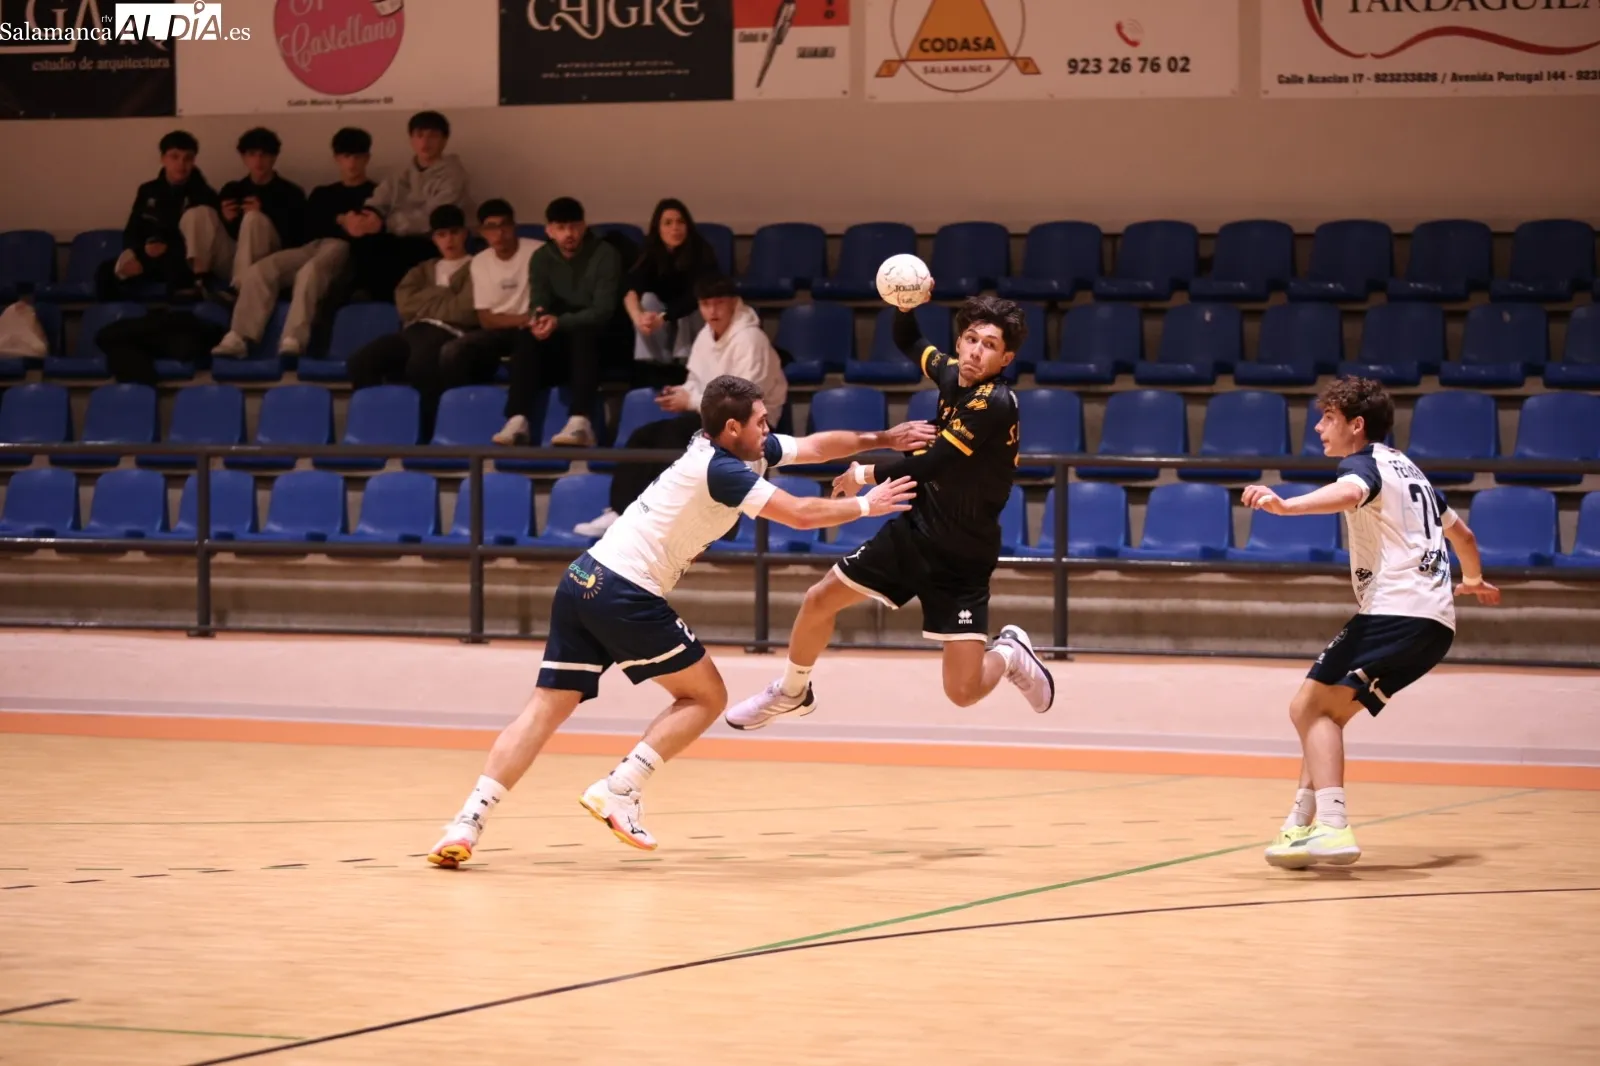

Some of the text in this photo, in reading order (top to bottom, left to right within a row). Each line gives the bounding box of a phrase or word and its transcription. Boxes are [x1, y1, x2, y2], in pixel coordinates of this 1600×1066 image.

[919, 36, 997, 53] CODASA
[32, 56, 170, 72] estudio de arquitectura
[923, 64, 992, 75] SALAMANCA
[1067, 56, 1191, 74] 923 26 76 02
[1278, 74, 1304, 84] Calle
[1307, 73, 1349, 84] Acacias
[1451, 72, 1494, 83] Avenida
[1497, 71, 1544, 84] Portugal
[1547, 70, 1566, 81] 144
